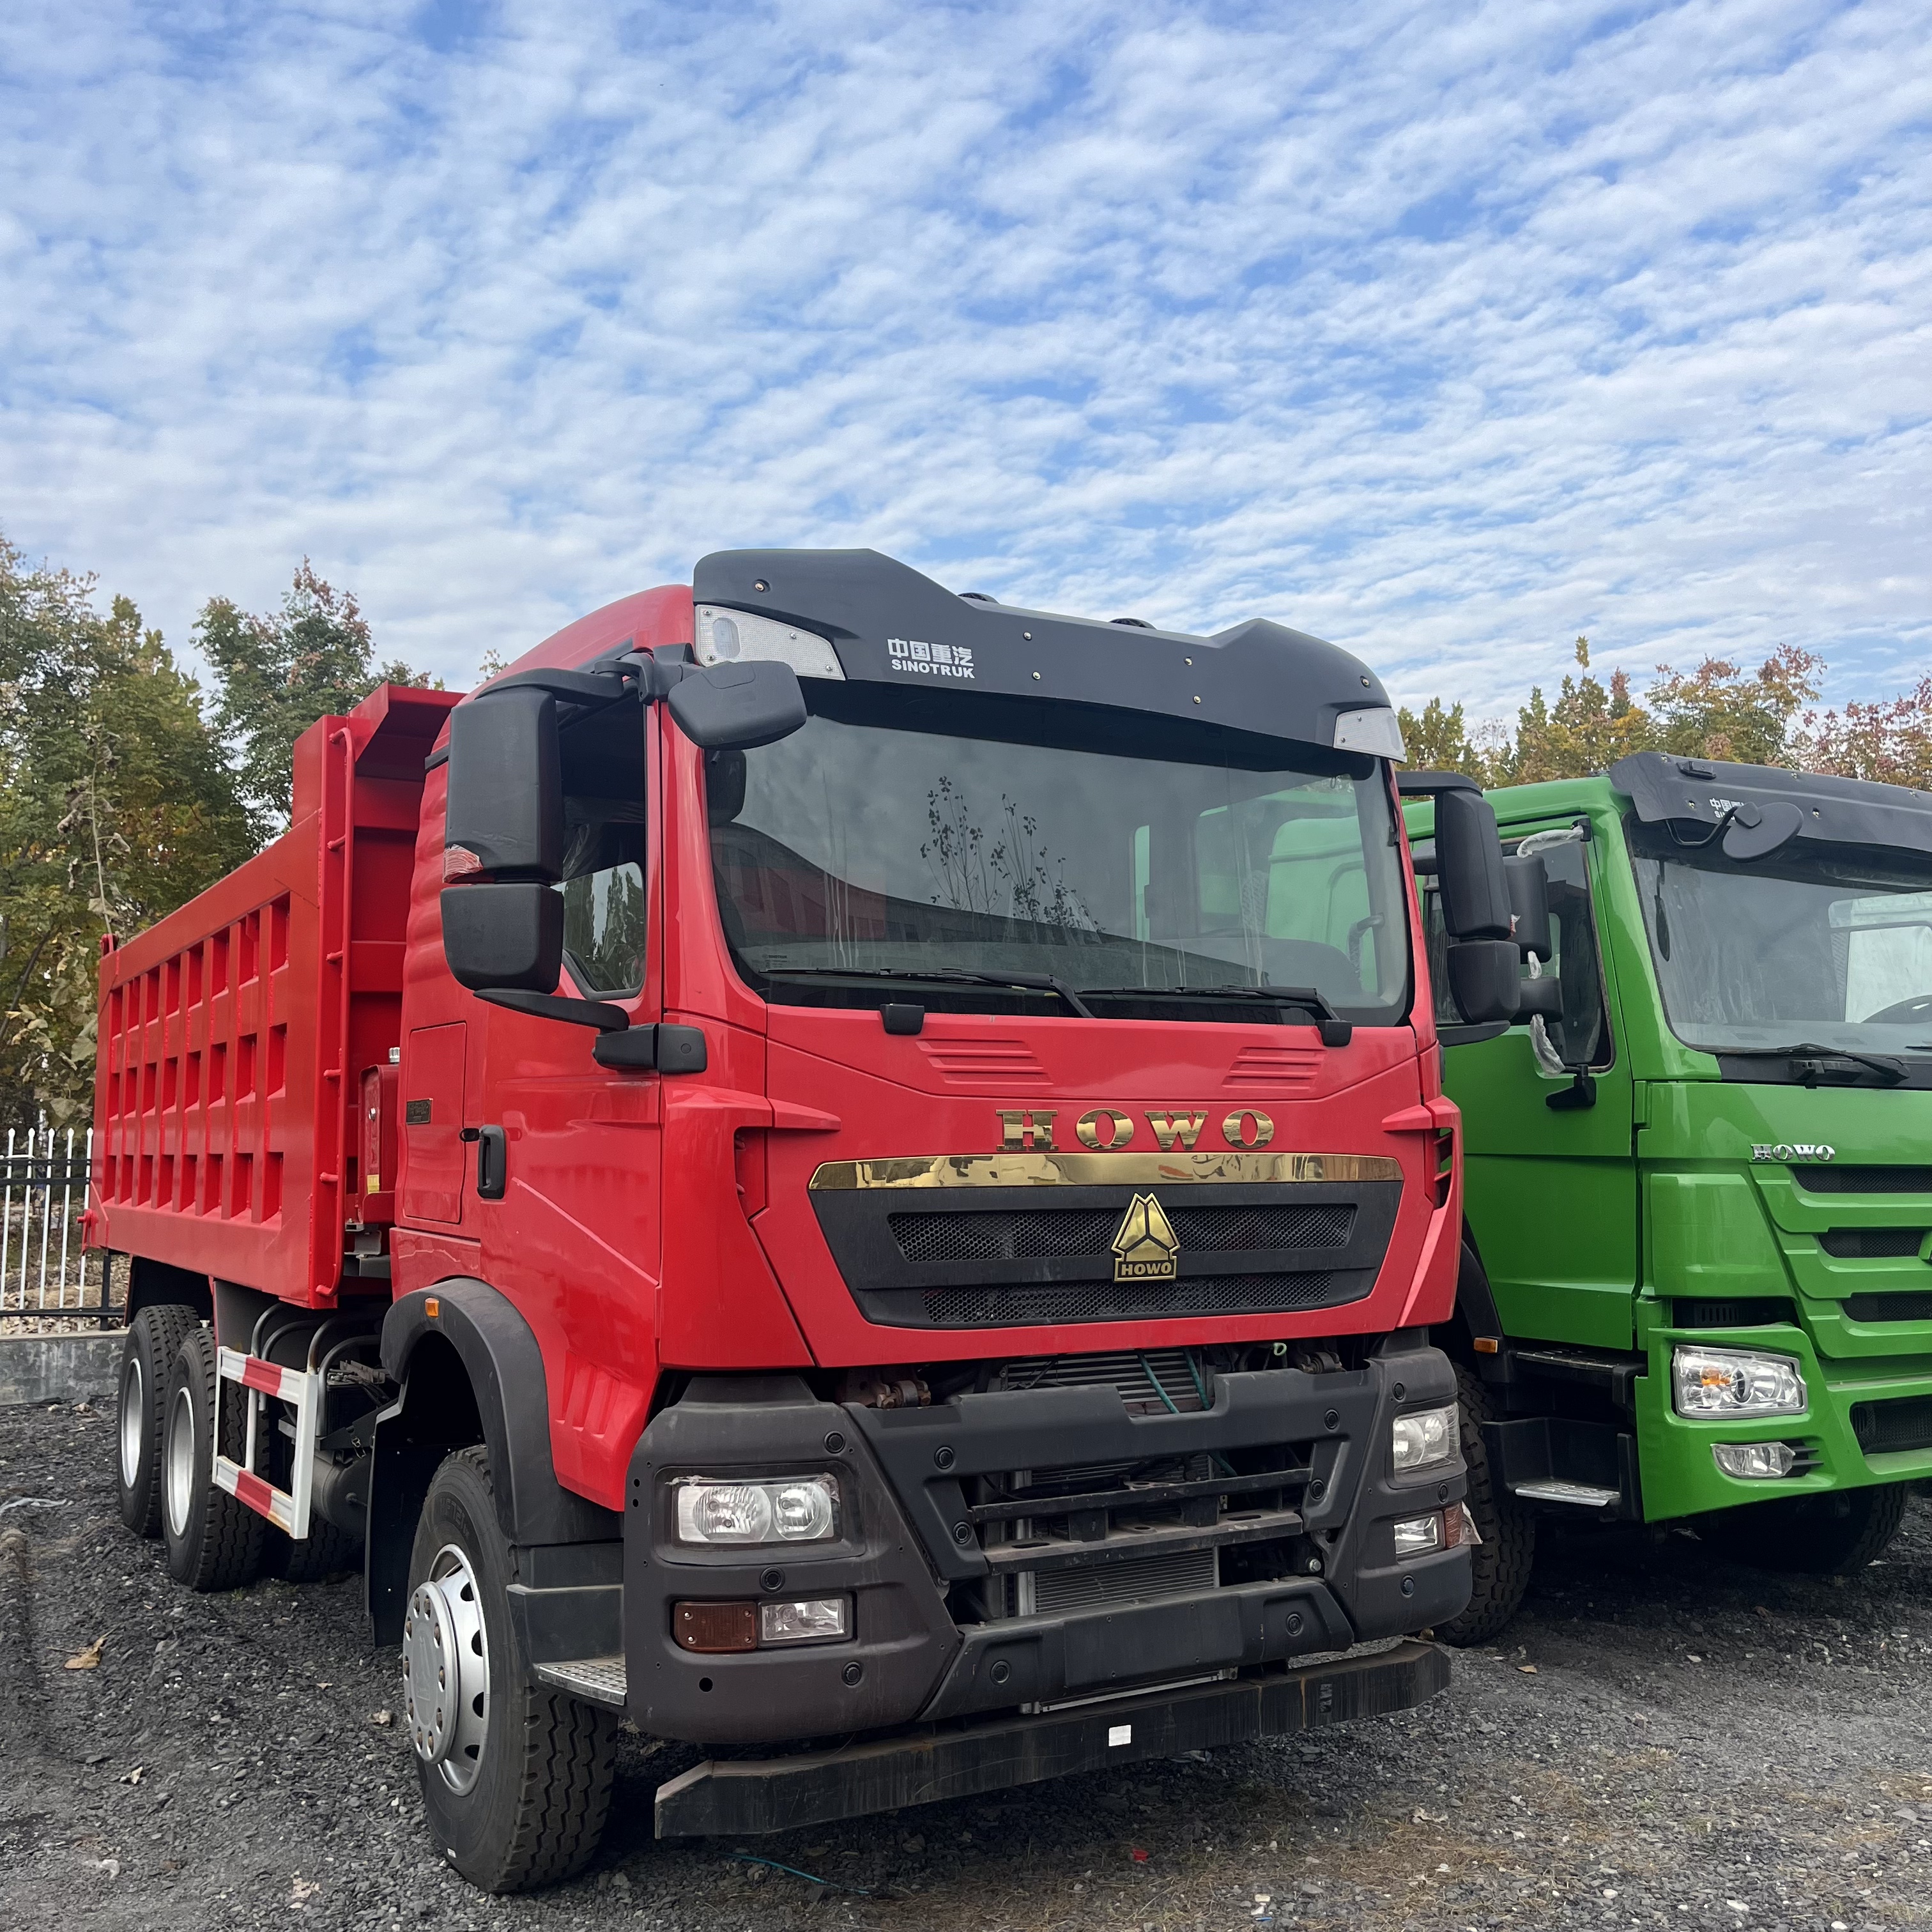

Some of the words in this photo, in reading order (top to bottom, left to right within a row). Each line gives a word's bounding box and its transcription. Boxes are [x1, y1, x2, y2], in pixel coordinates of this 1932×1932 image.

[887, 638, 974, 666] 中国重汽
[892, 659, 975, 678] SINOTRUK
[1709, 797, 1744, 812] 中国
[995, 1108, 1275, 1151] HOWO
[1751, 1144, 1836, 1162] HOWO
[1121, 1262, 1172, 1276] HOWO
